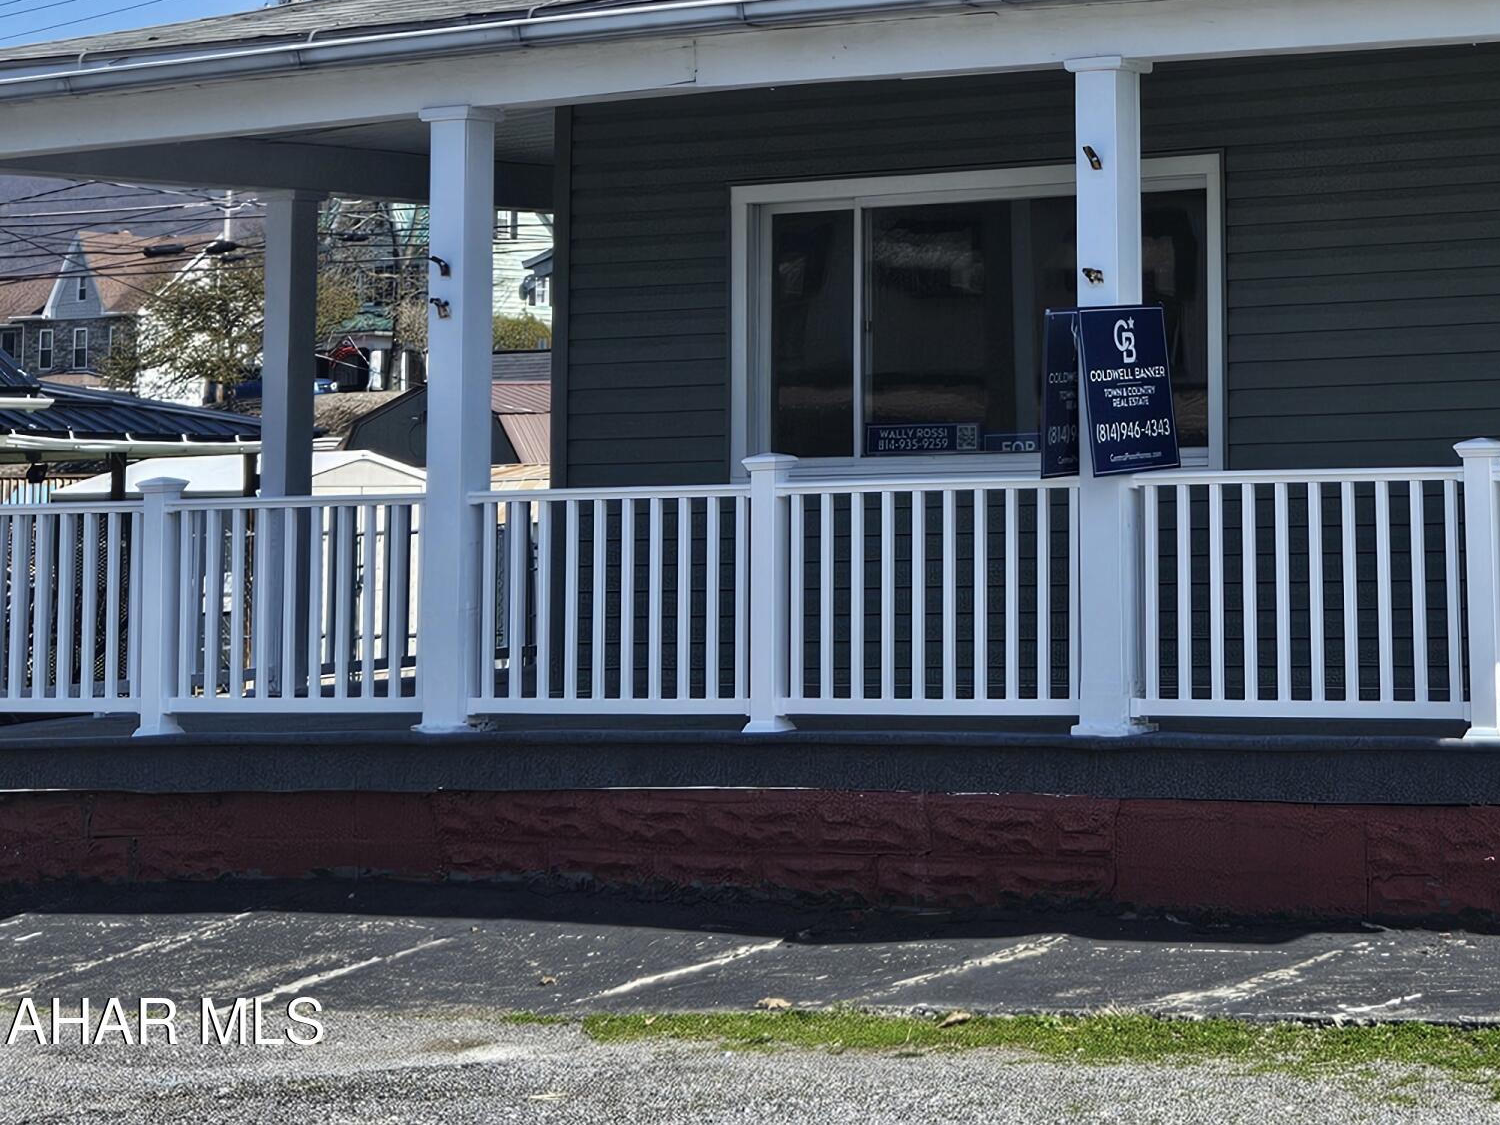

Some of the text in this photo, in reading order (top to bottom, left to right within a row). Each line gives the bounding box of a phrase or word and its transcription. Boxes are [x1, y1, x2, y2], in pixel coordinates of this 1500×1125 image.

[1090, 366, 1166, 382] COLDWELL BANKER
[1104, 387, 1122, 397] TOWN
[1127, 385, 1156, 396] COUNTRY
[1112, 396, 1149, 408] REAL ESTATE
[880, 427, 948, 438] WALLY ROSSI
[878, 438, 948, 450] 814-935-9259
